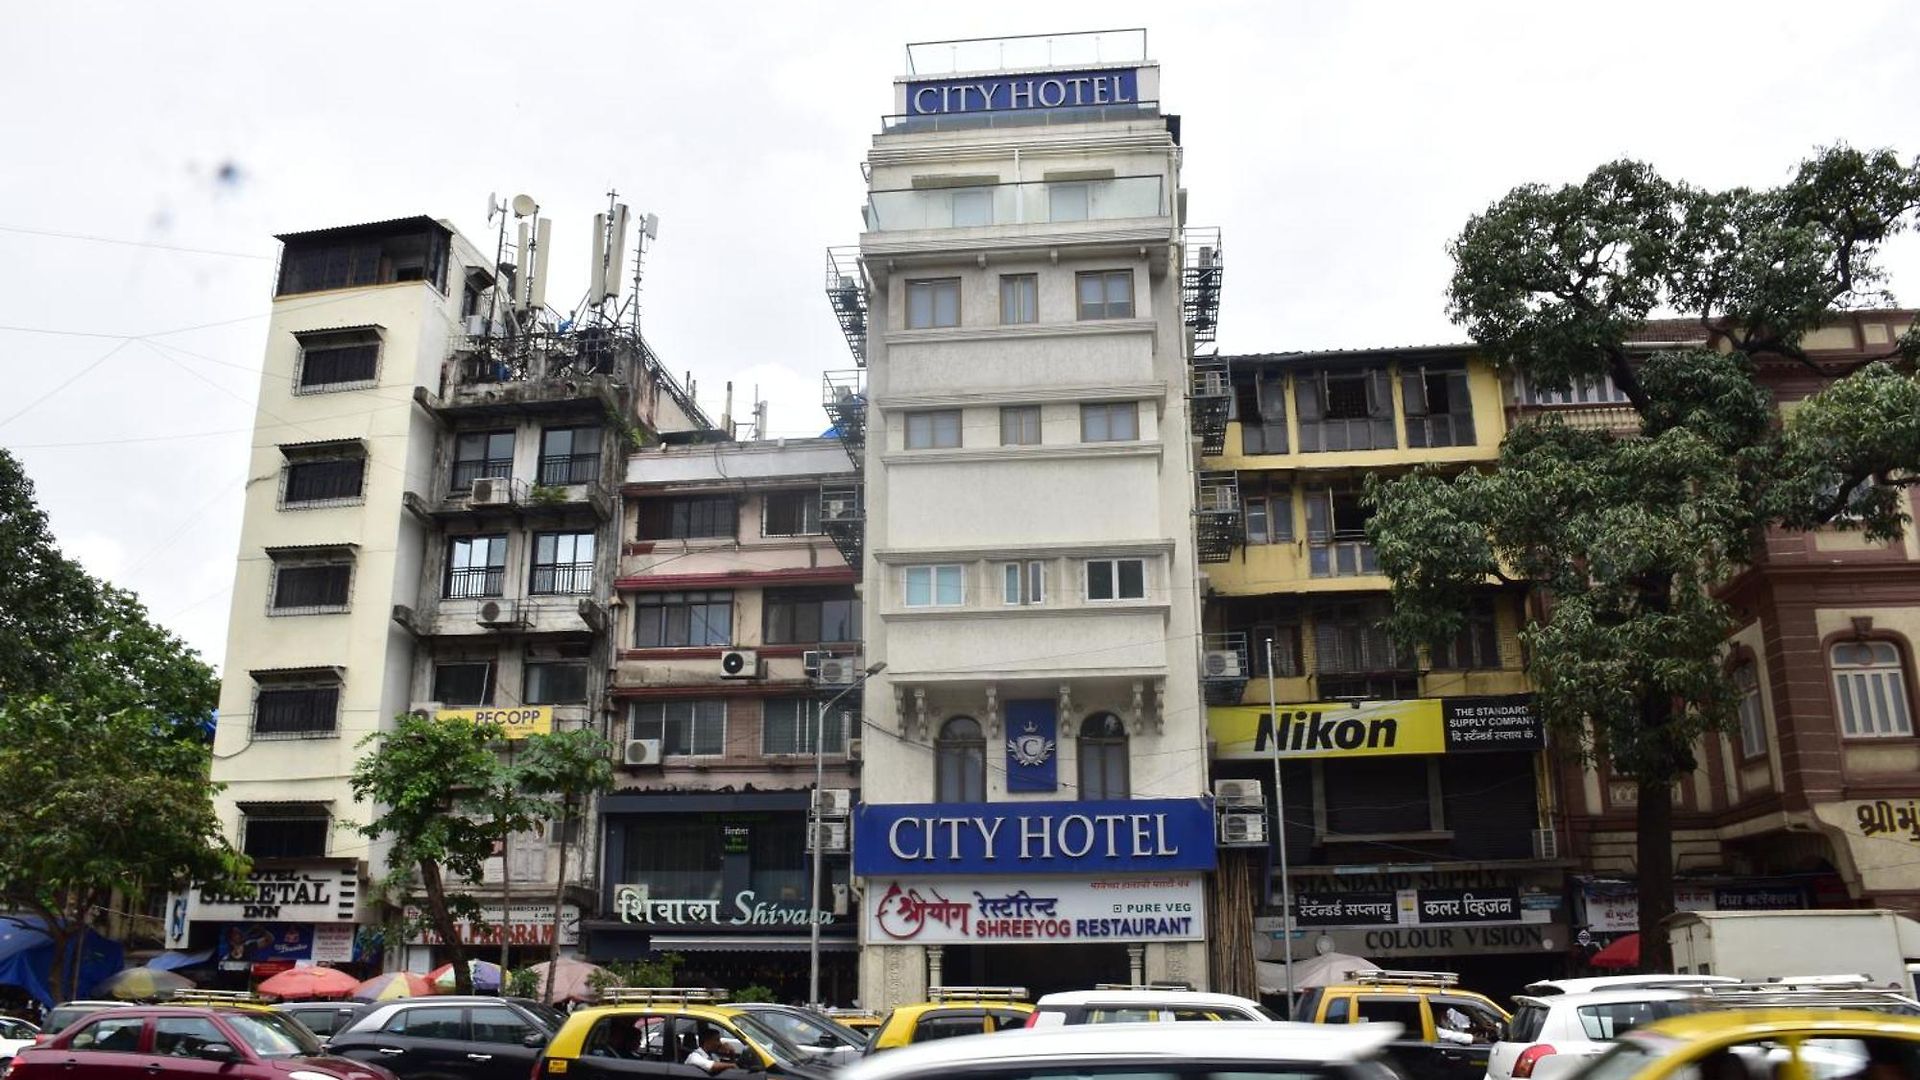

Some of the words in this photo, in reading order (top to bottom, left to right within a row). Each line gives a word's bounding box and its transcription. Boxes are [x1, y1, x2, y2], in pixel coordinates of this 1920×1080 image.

[914, 83, 1000, 115] CITY
[1008, 76, 1130, 108] HOTEL
[1449, 718, 1488, 728] SUPPLY
[1488, 716, 1536, 726] COMPANY
[1455, 707, 1475, 716] THE
[1476, 705, 1529, 716] STANDARD
[1254, 710, 1398, 752] Nikon
[888, 816, 1006, 860] CITY
[1017, 813, 1179, 859] HOTEL
[243, 905, 281, 919] INN
[618, 889, 721, 925] शिवाला
[730, 890, 835, 925] Shivaa
[1127, 903, 1161, 914] PURE
[1166, 902, 1192, 912] VEG
[976, 919, 1071, 938] SHREEYOG
[1076, 916, 1192, 938] RESTAURANT
[1365, 929, 1456, 951] COLOUR
[1465, 926, 1544, 948] VISION
